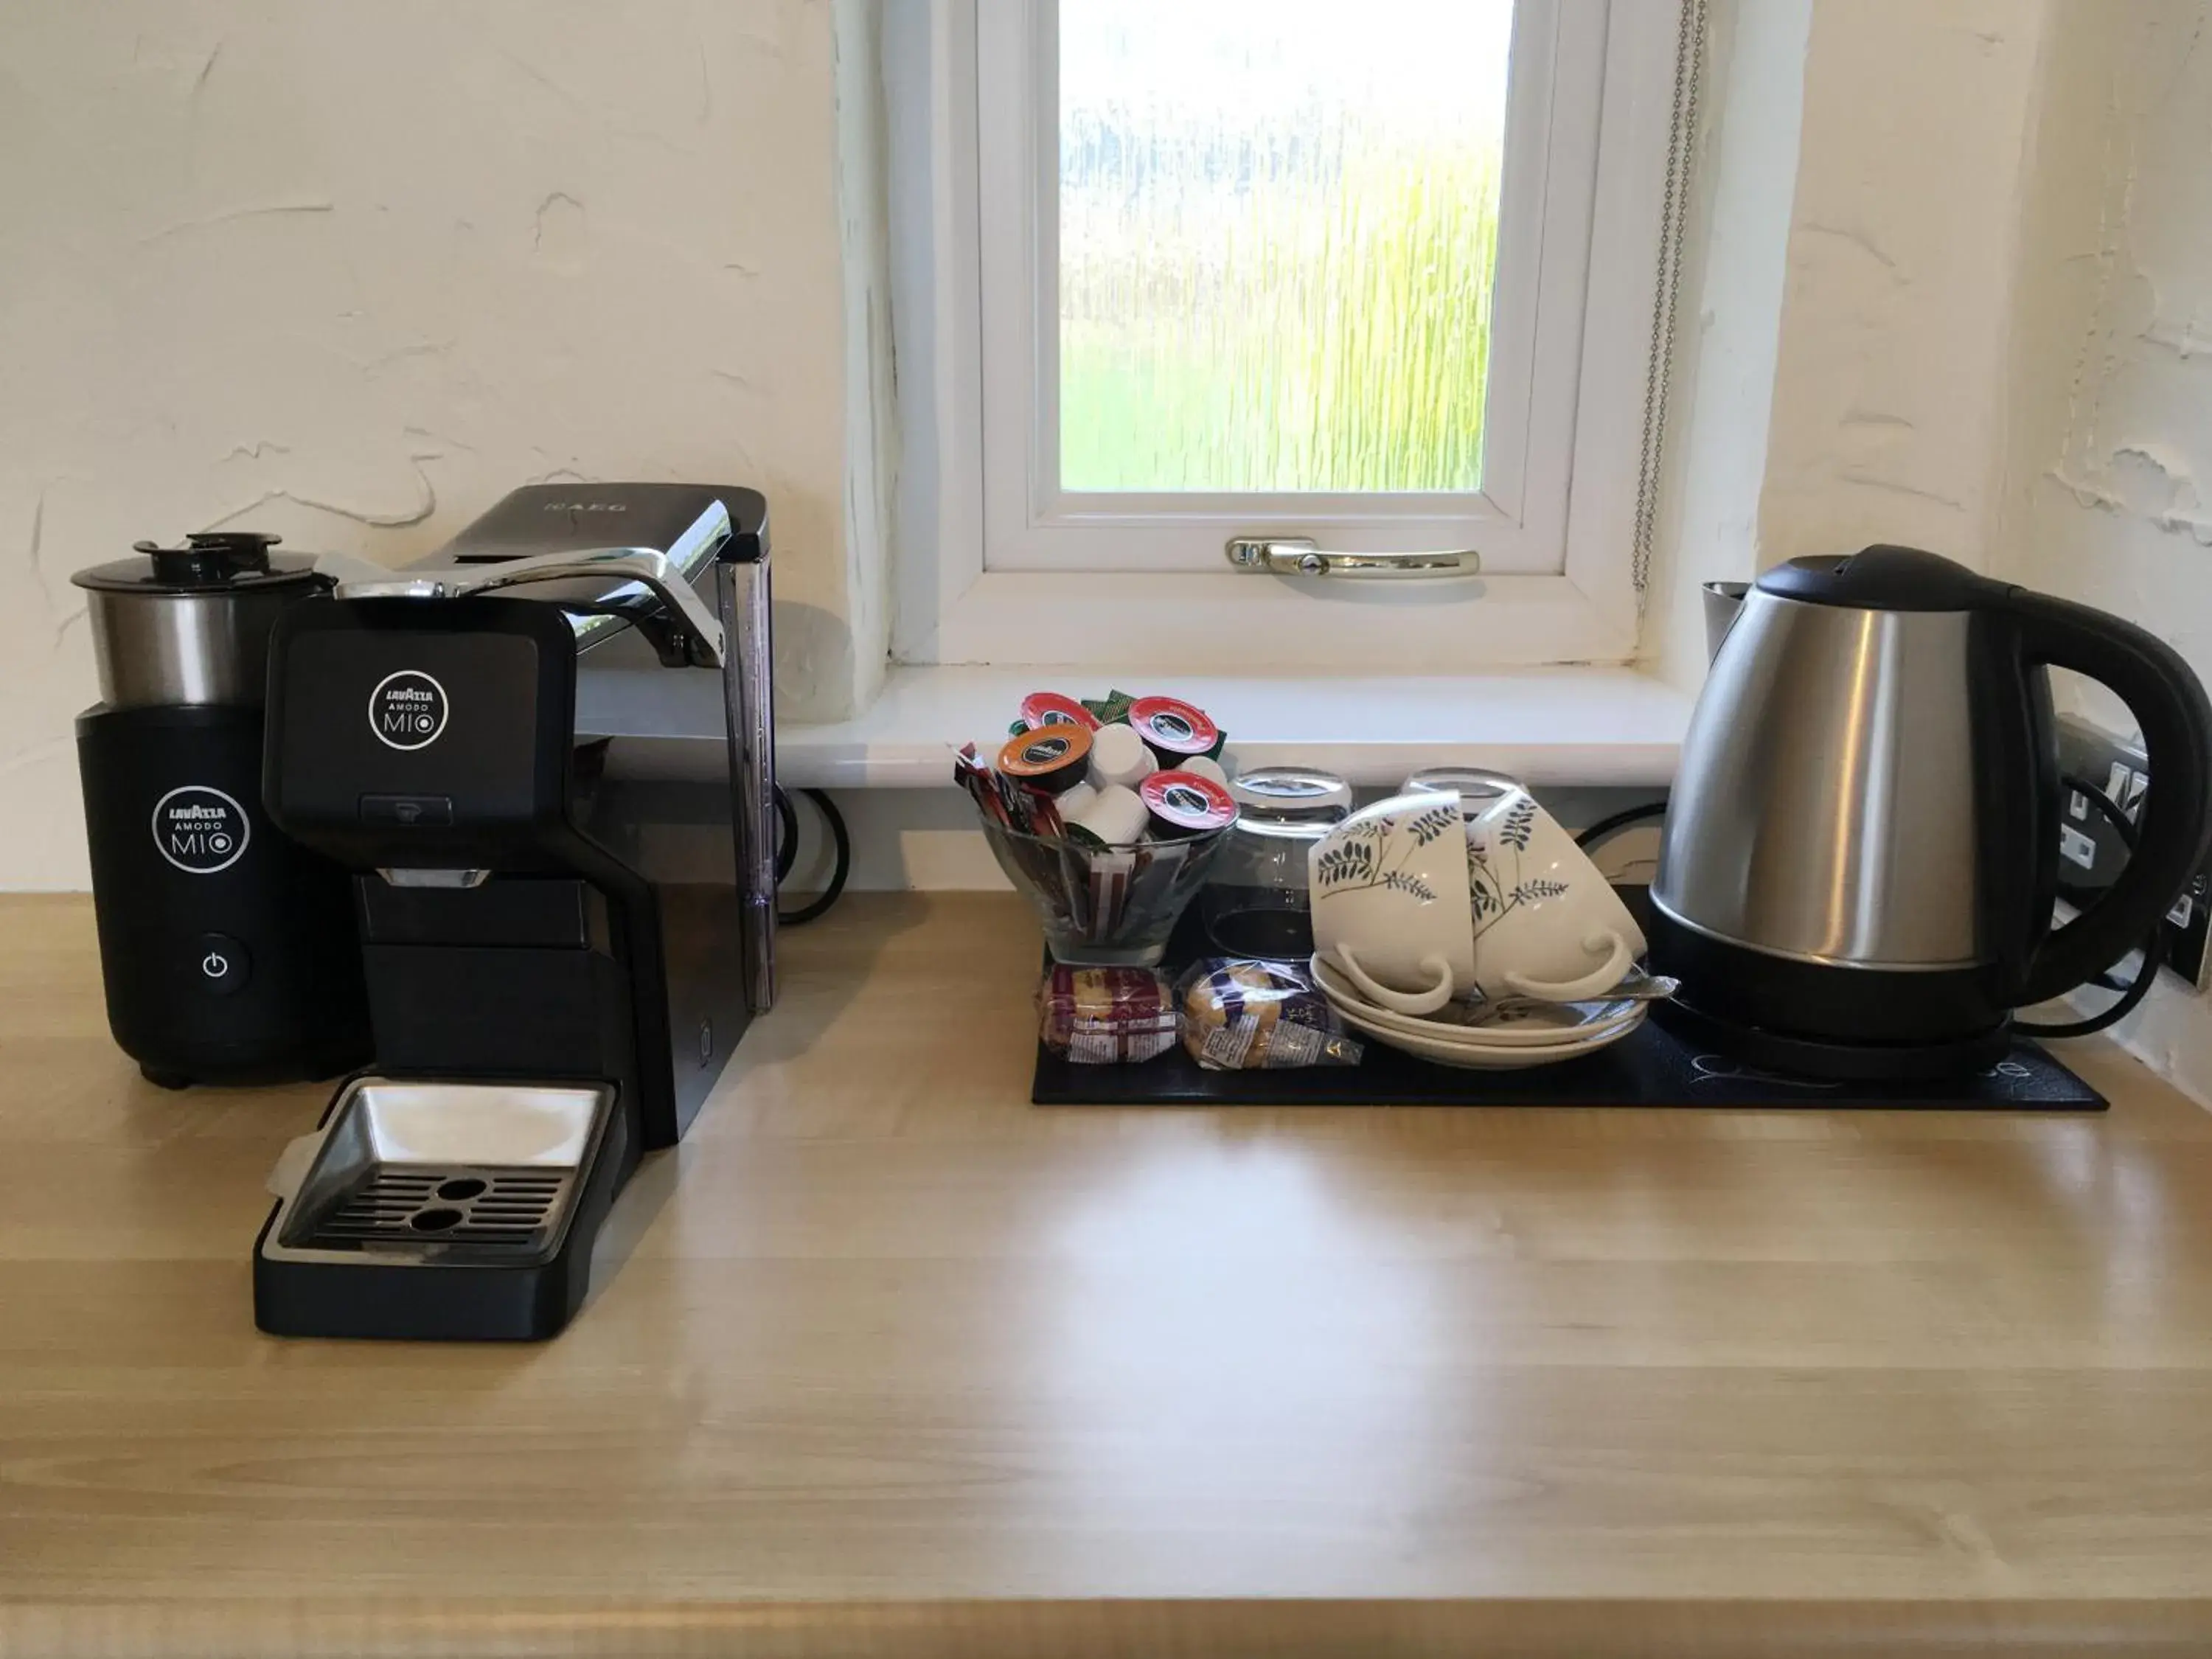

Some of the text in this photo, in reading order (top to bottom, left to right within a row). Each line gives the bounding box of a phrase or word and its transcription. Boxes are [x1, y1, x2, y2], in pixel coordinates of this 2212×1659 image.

[386, 687, 433, 701] LAVAZZA
[389, 703, 428, 711] AMODO
[384, 712, 434, 733] MIO
[170, 804, 226, 818] LAVAZZA
[175, 822, 222, 830] AMODO
[171, 832, 232, 854] MIO
